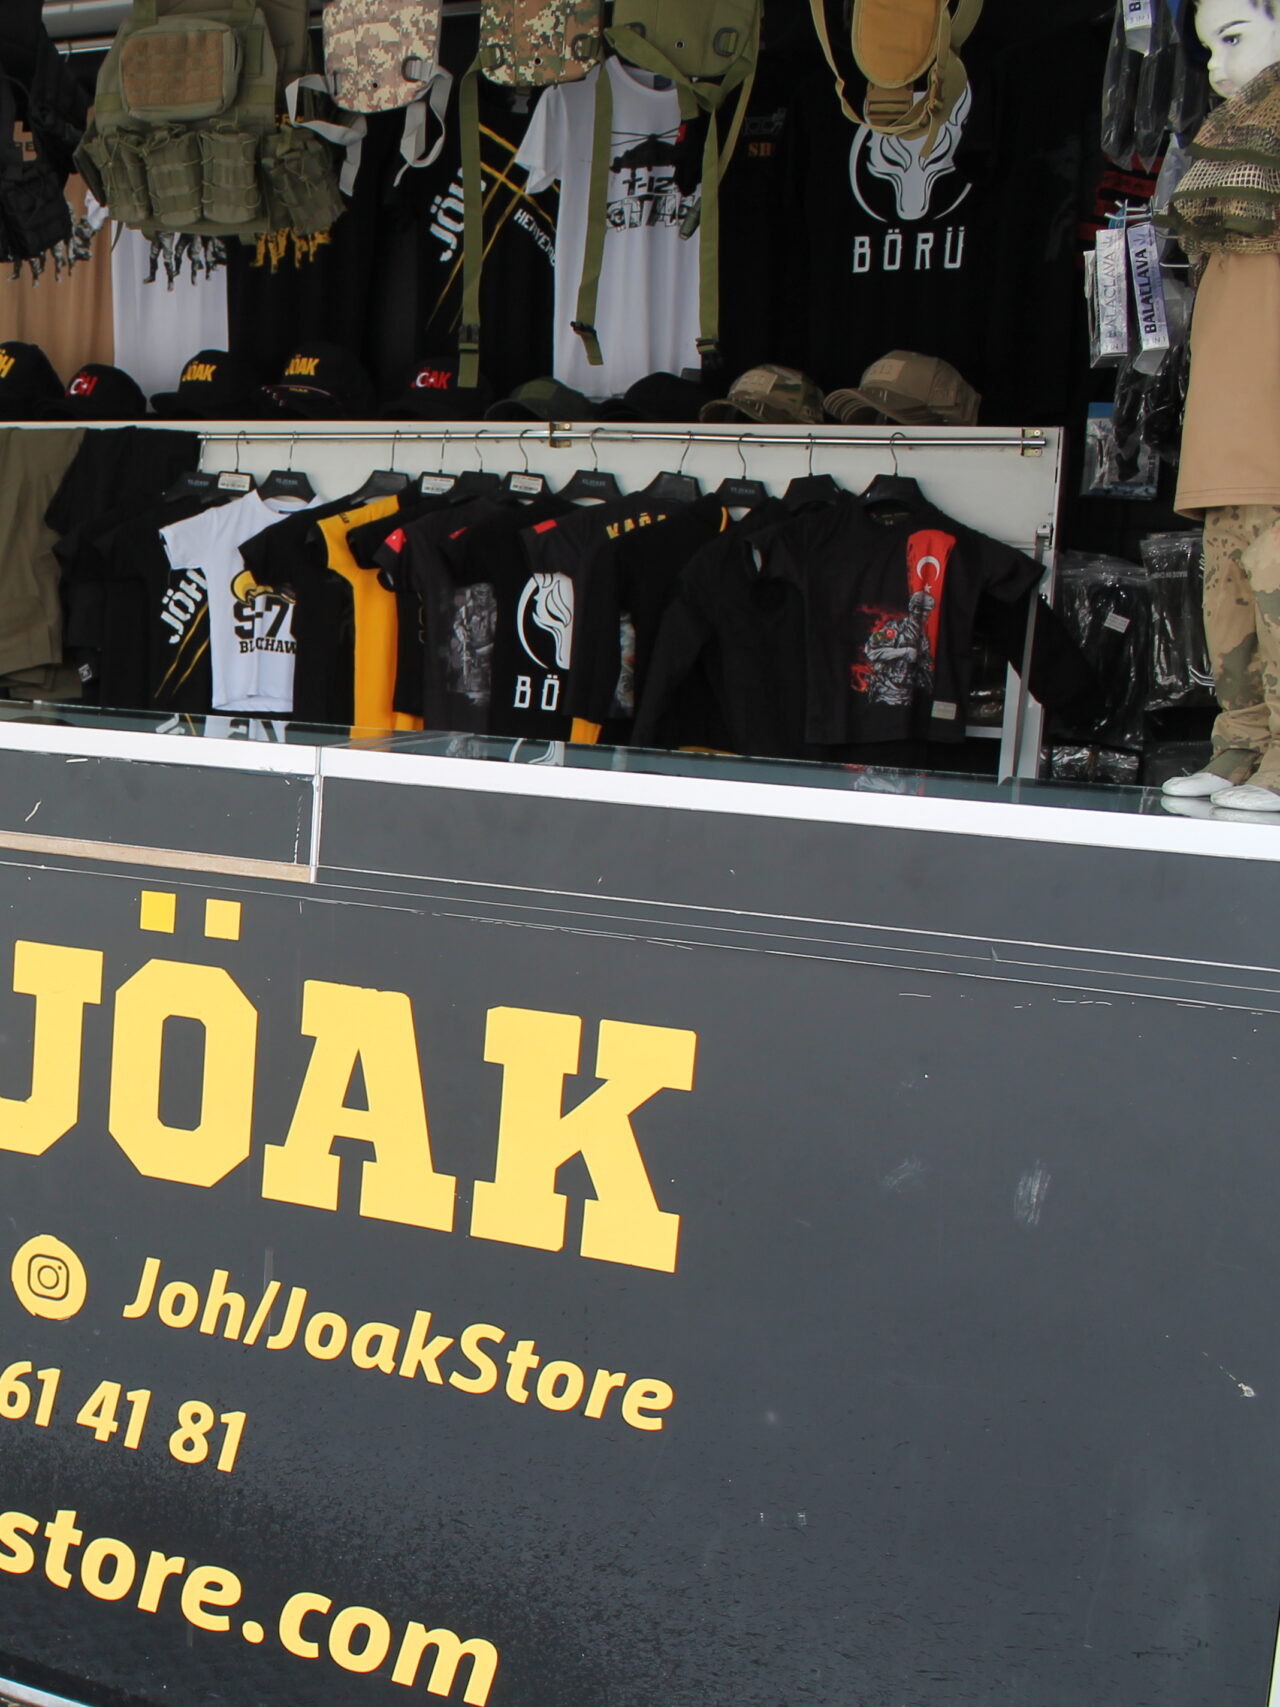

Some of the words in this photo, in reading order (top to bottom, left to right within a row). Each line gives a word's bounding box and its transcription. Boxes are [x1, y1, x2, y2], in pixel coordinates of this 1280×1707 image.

[852, 226, 966, 273] BÖRÜ
[1134, 248, 1157, 335] BALACLAVA
[122, 1257, 674, 1431] Joh/JoakStore
[75, 1381, 152, 1449] 41
[168, 1401, 247, 1472] 81
